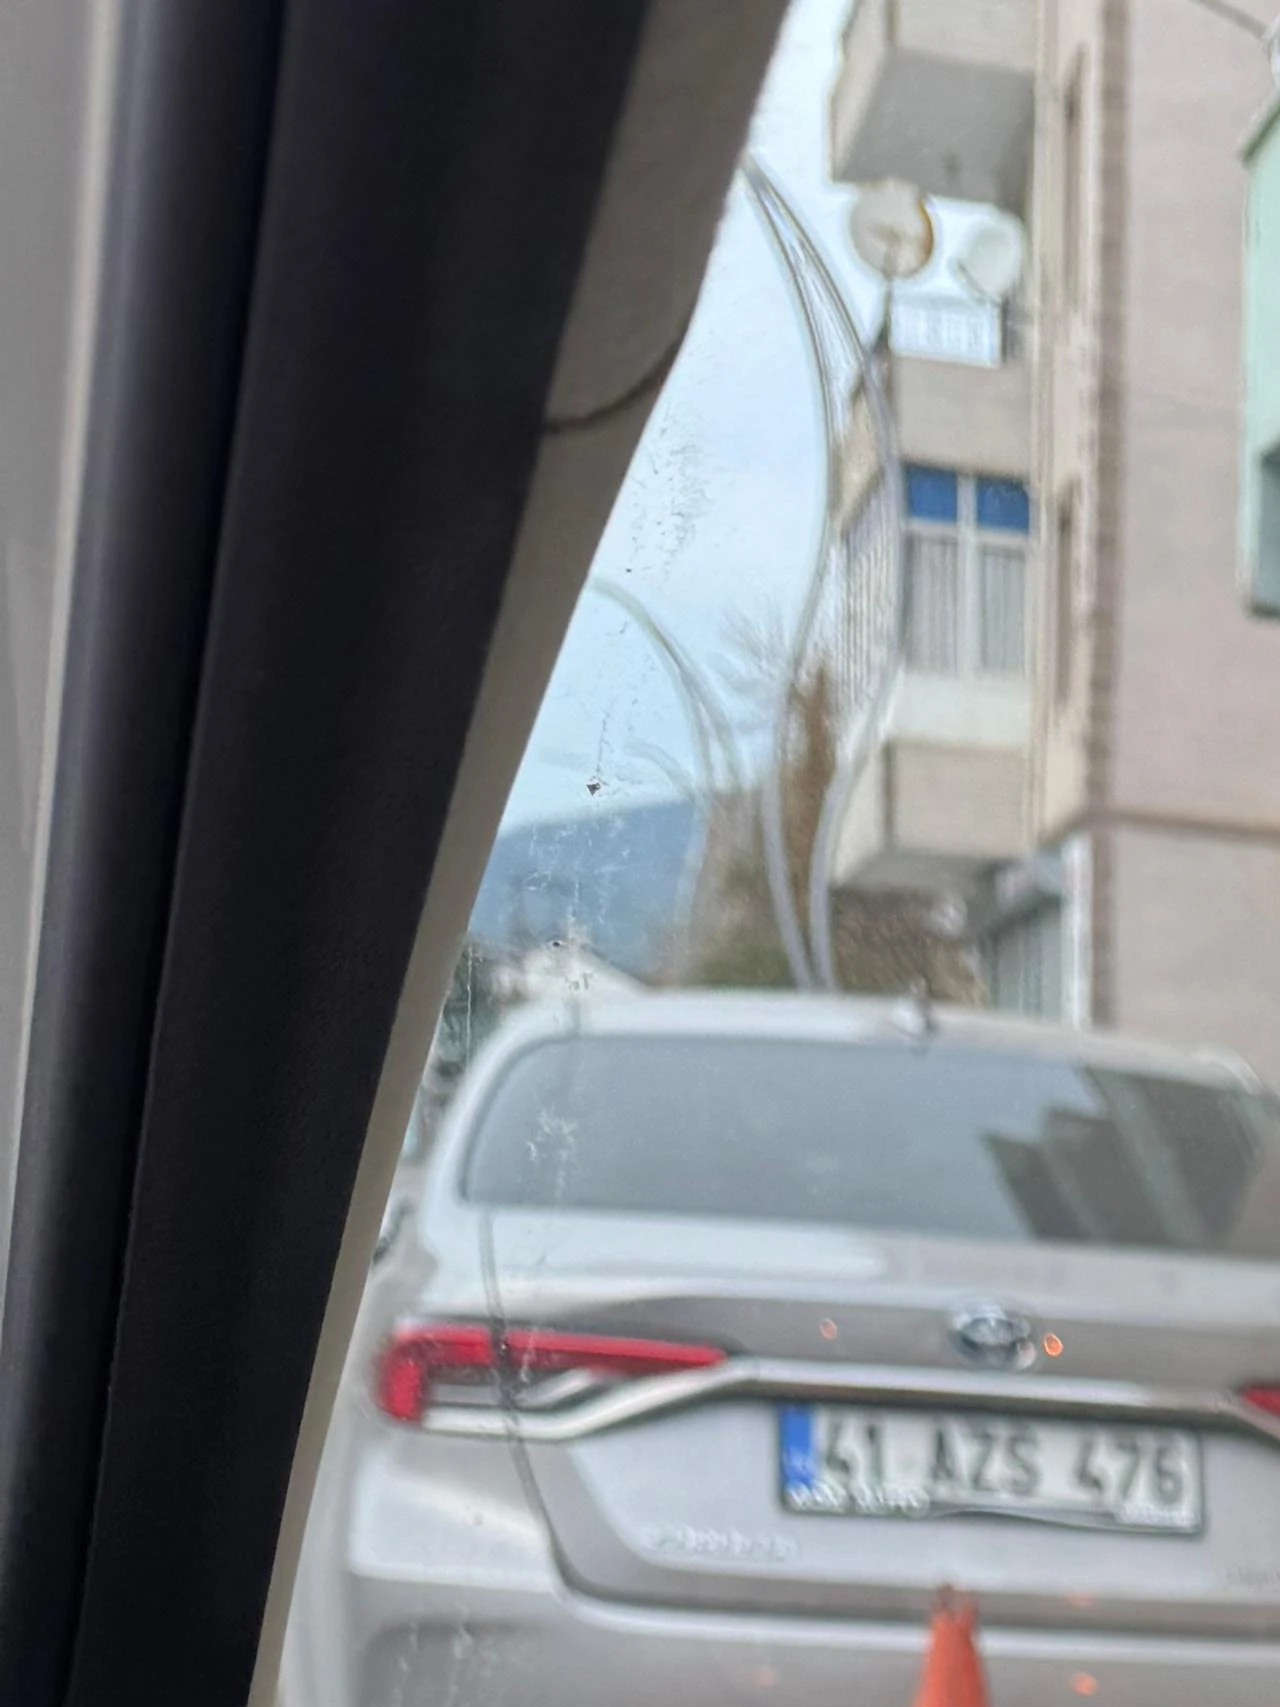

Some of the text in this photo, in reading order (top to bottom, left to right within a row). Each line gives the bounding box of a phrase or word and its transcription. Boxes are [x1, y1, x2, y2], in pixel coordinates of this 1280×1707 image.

[820, 1418, 1184, 1502] 41 AZS 476
